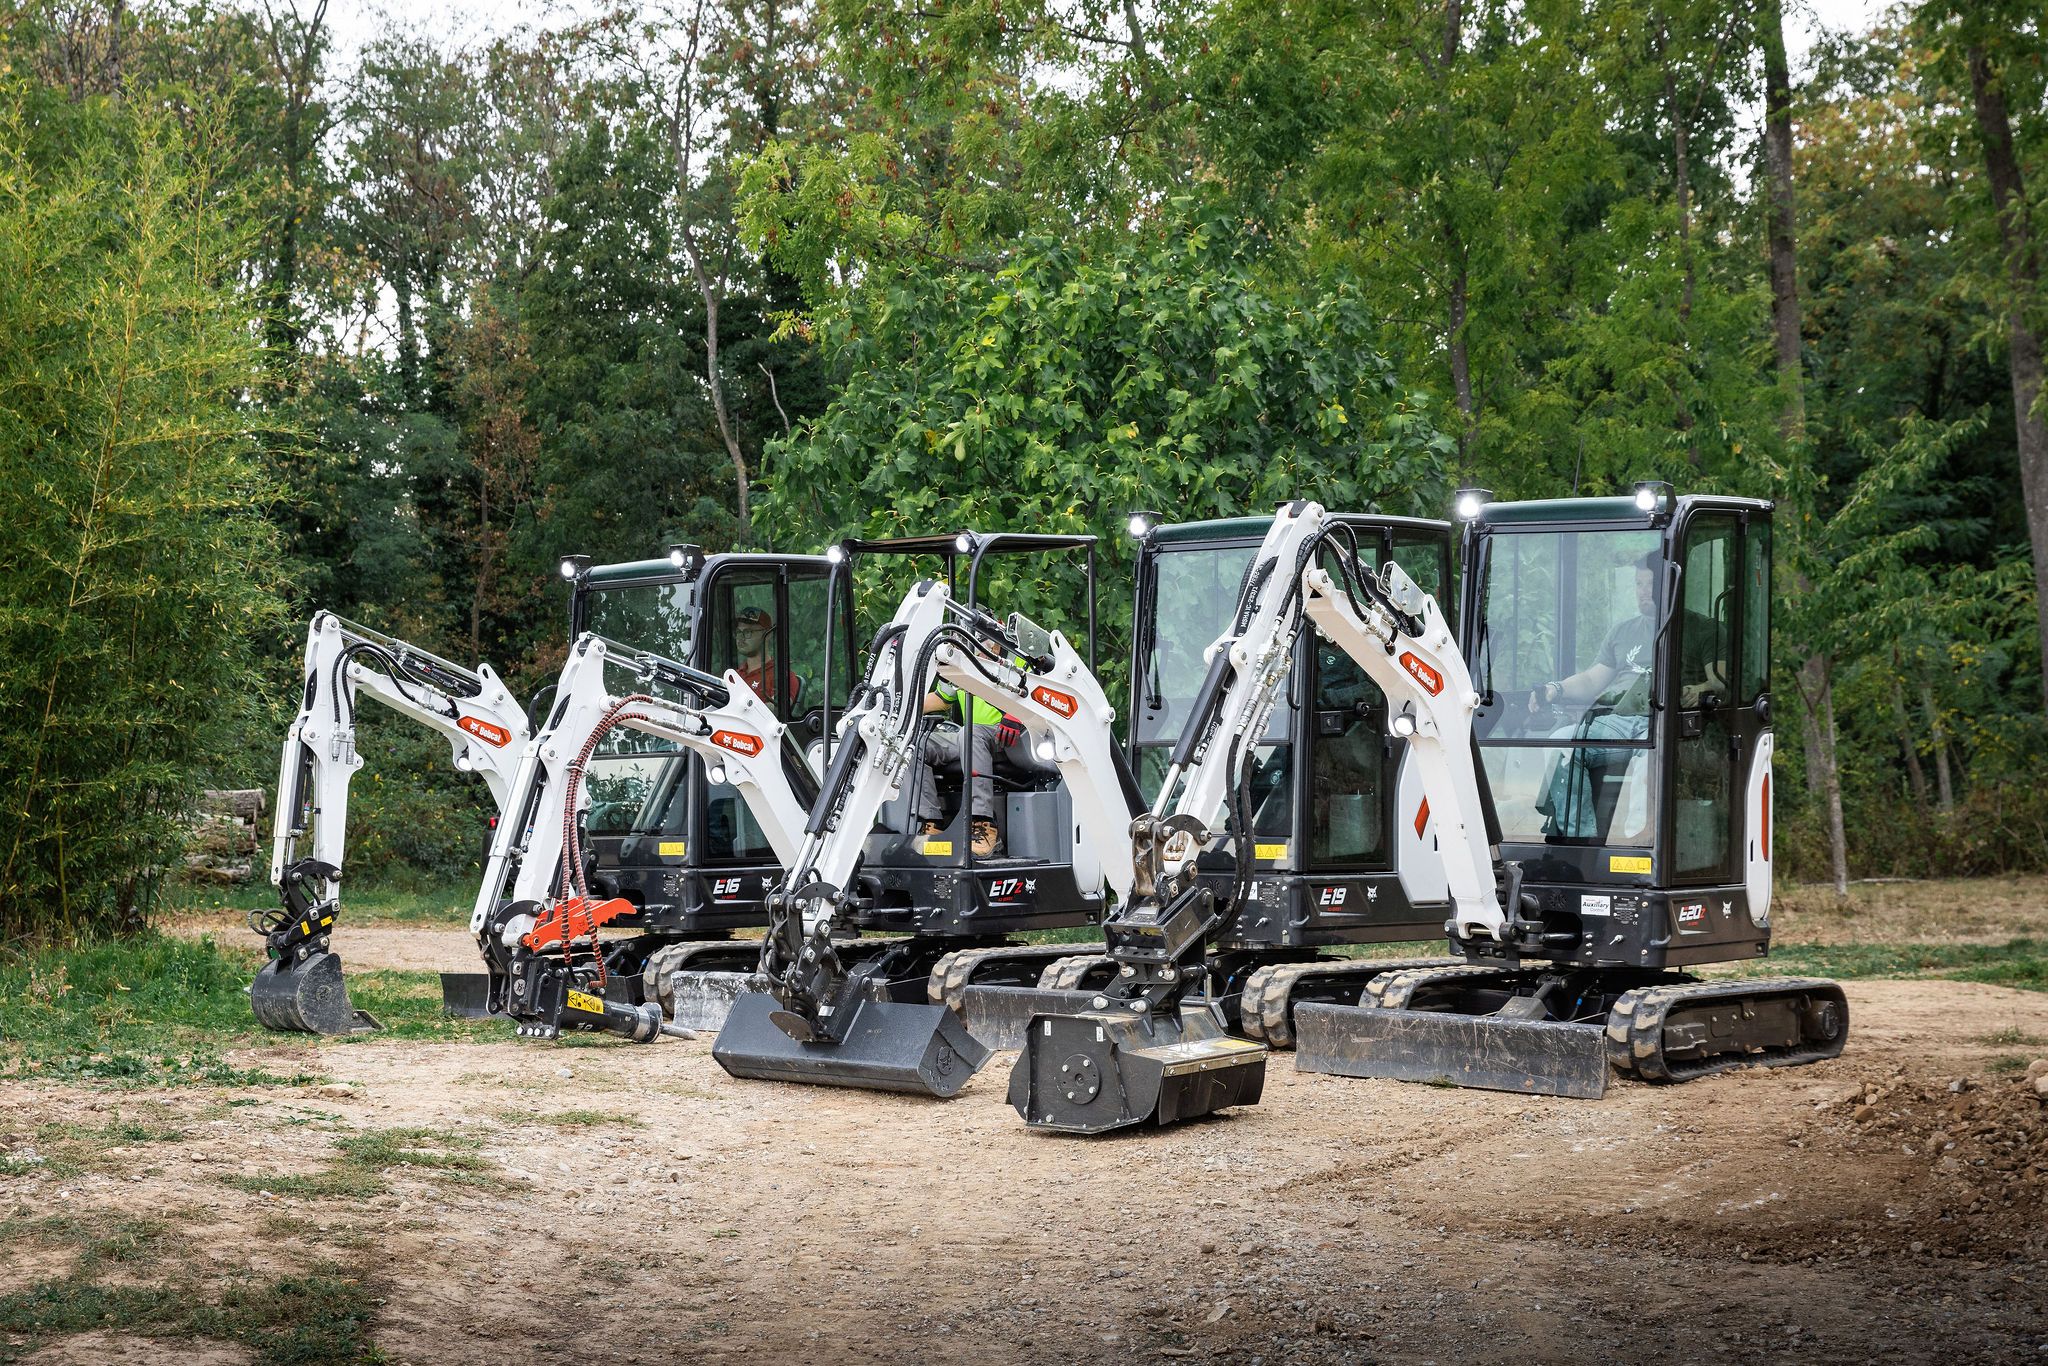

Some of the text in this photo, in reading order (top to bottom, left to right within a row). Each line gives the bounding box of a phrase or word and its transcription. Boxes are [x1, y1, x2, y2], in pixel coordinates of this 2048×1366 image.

[1417, 666, 1436, 690] Bobcat
[1051, 696, 1070, 713] Bobcat
[479, 726, 502, 743] Bobcat
[732, 738, 755, 752] Bobcat
[712, 878, 742, 895] E16
[1319, 887, 1347, 905] E19
